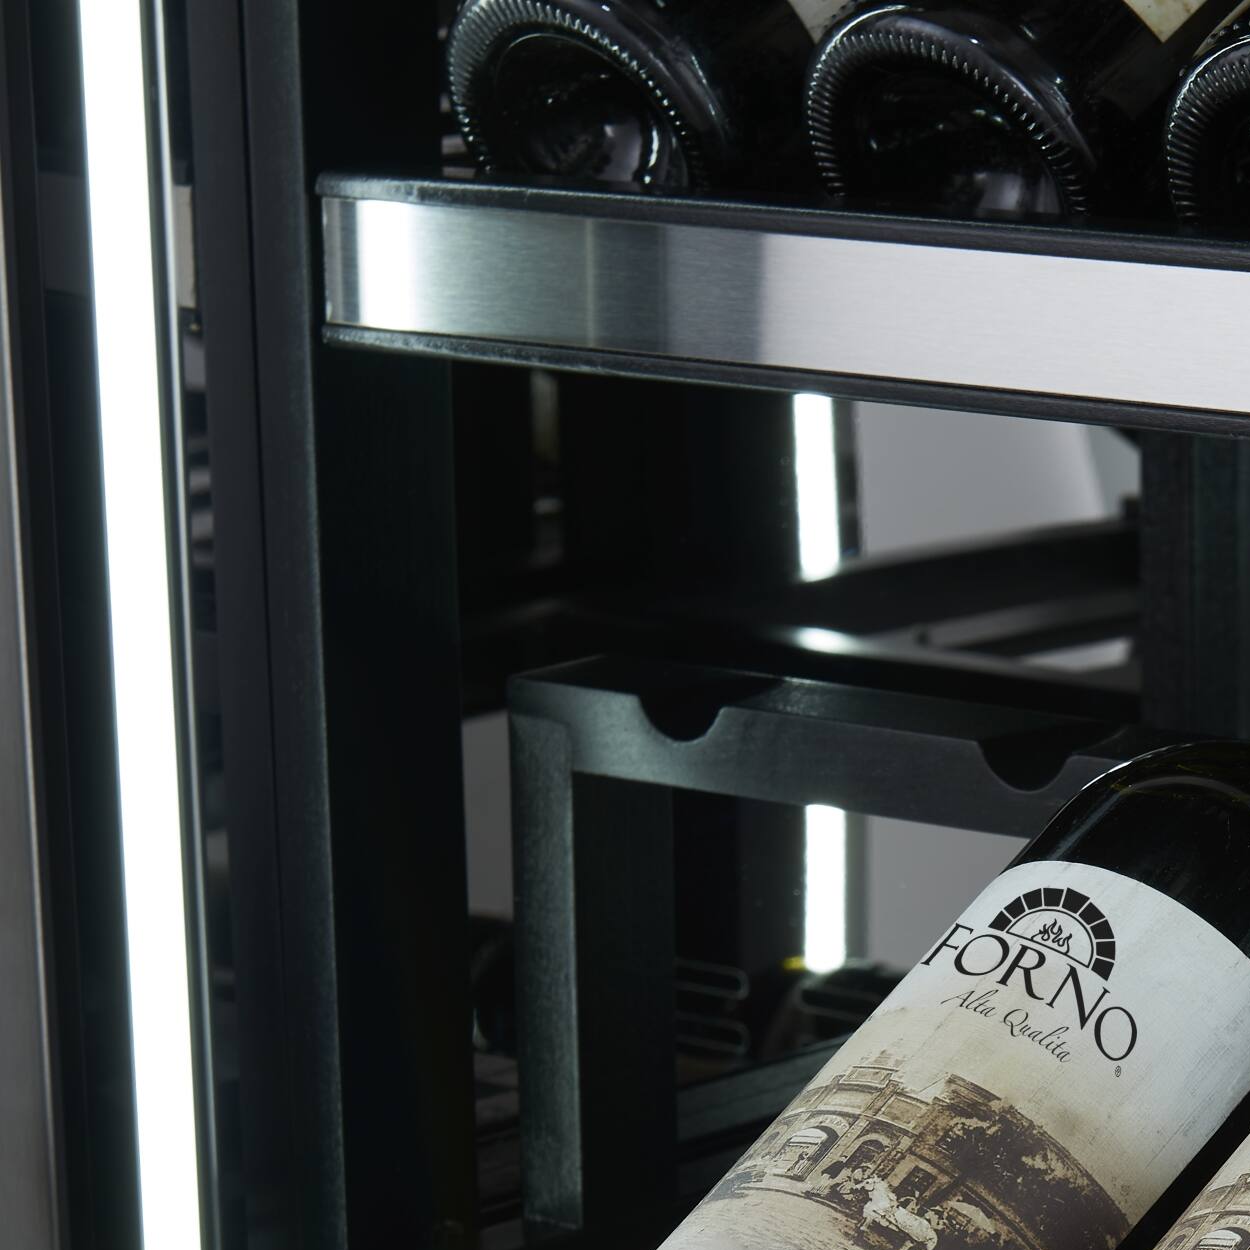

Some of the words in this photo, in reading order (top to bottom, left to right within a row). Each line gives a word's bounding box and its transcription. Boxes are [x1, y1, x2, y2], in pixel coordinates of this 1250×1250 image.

[920, 922, 1138, 1062] FORNO
[940, 989, 999, 1018] Alta
[1001, 1008, 1072, 1063] Qualita
